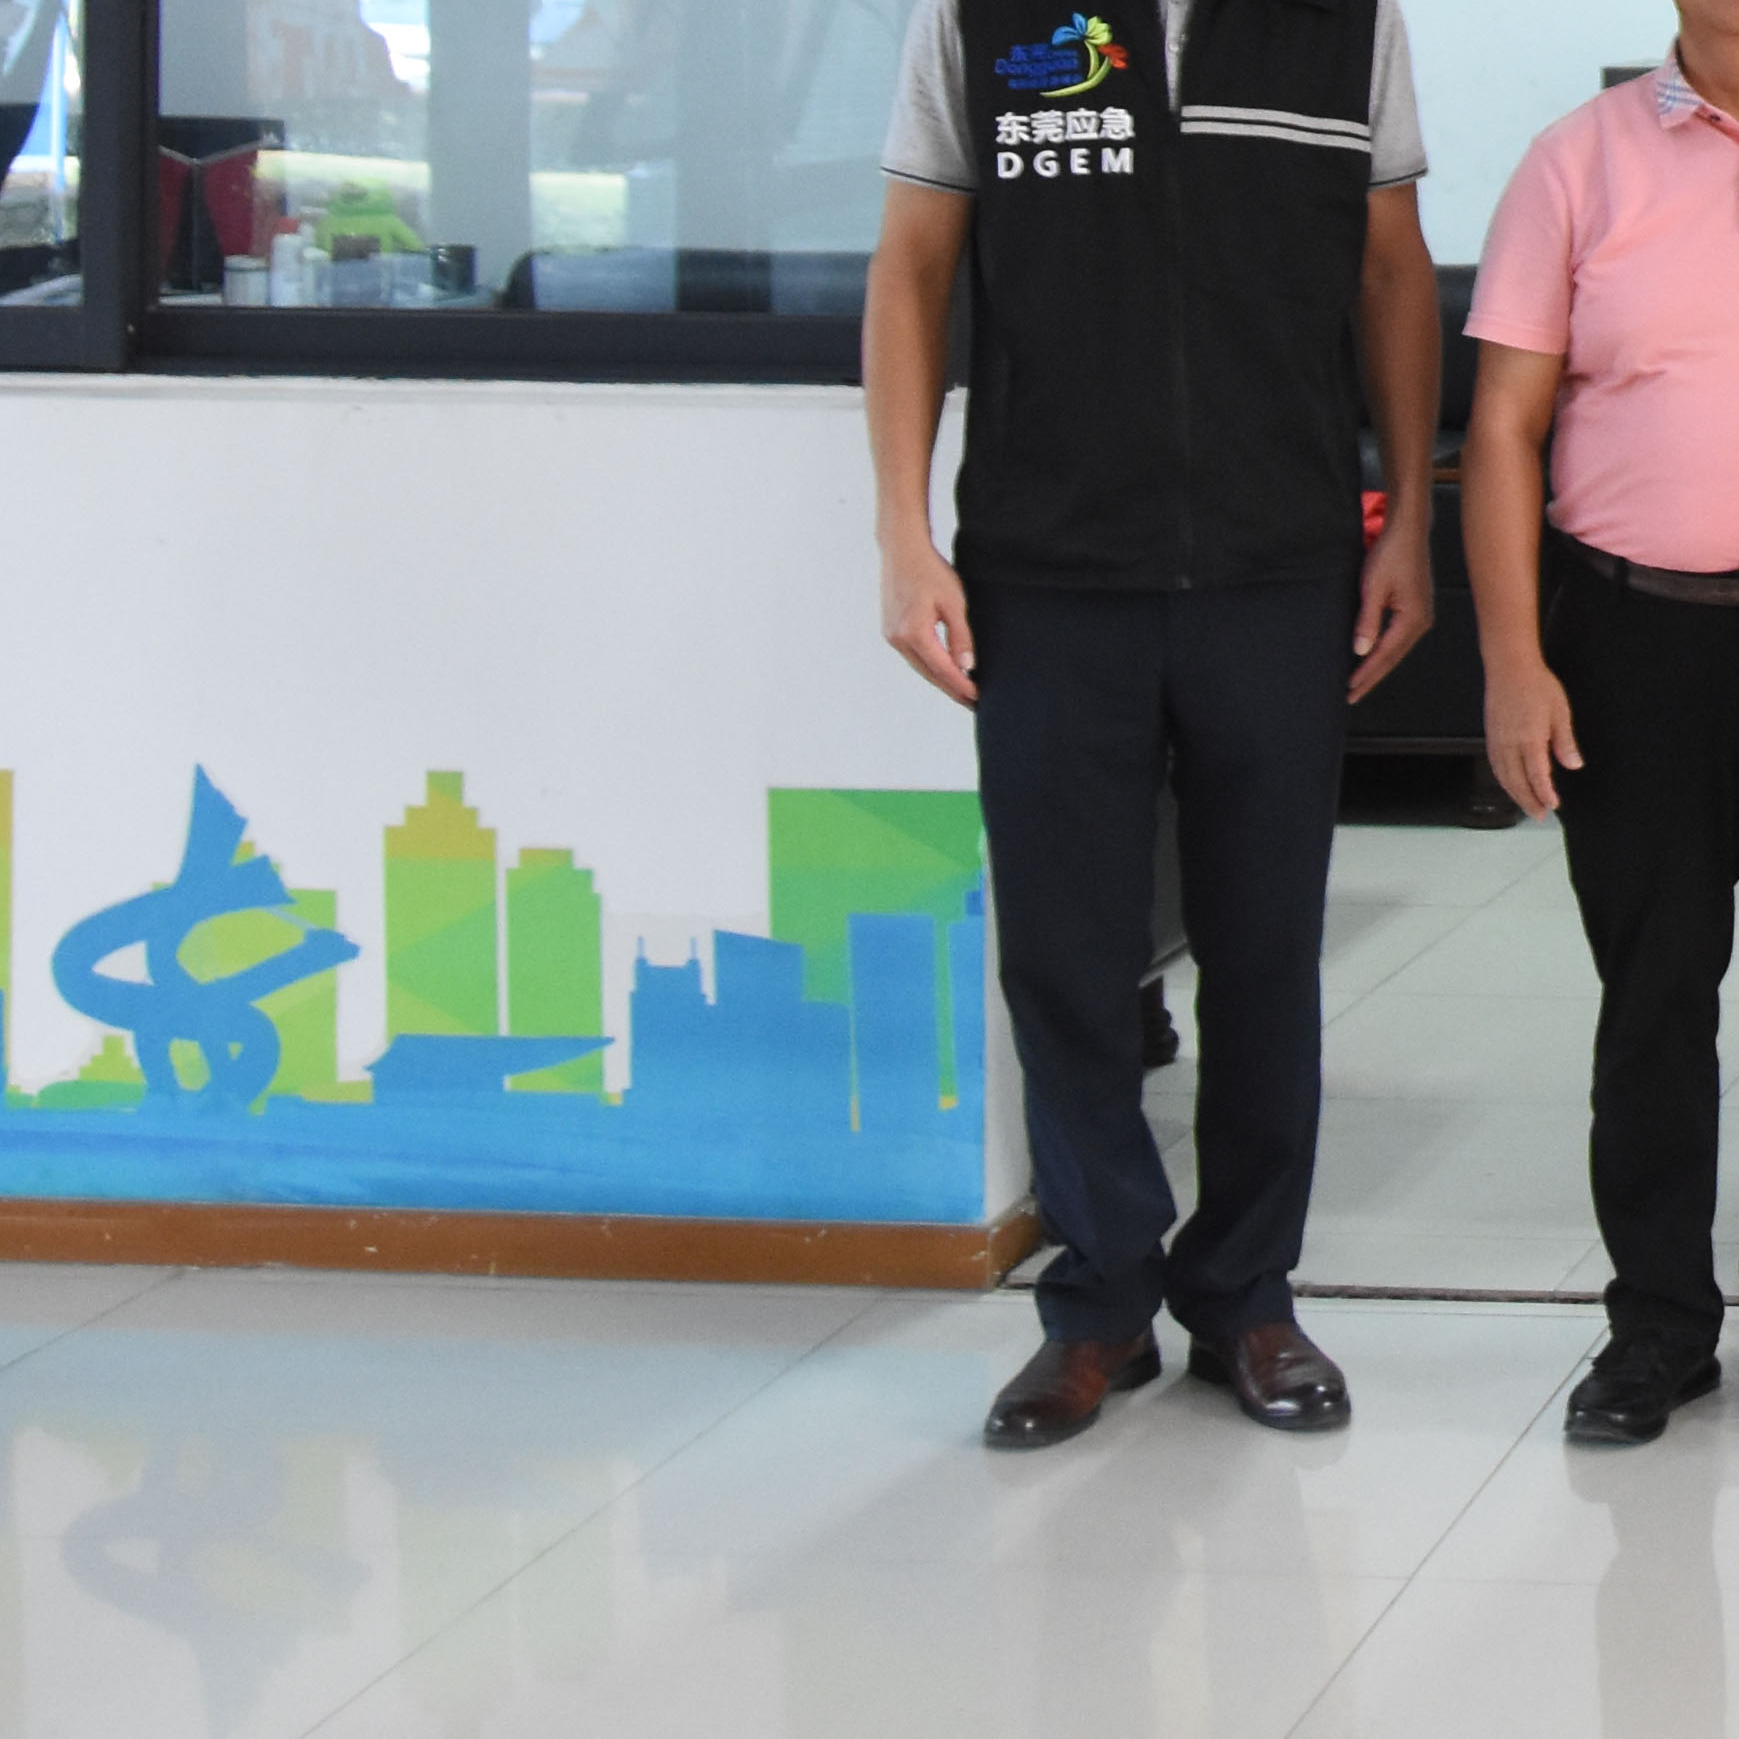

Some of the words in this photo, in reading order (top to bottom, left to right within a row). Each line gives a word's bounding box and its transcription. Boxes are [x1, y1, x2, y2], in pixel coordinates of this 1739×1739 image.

[994, 106, 1136, 146] 东莞应急
[996, 147, 1135, 180] DGEM
